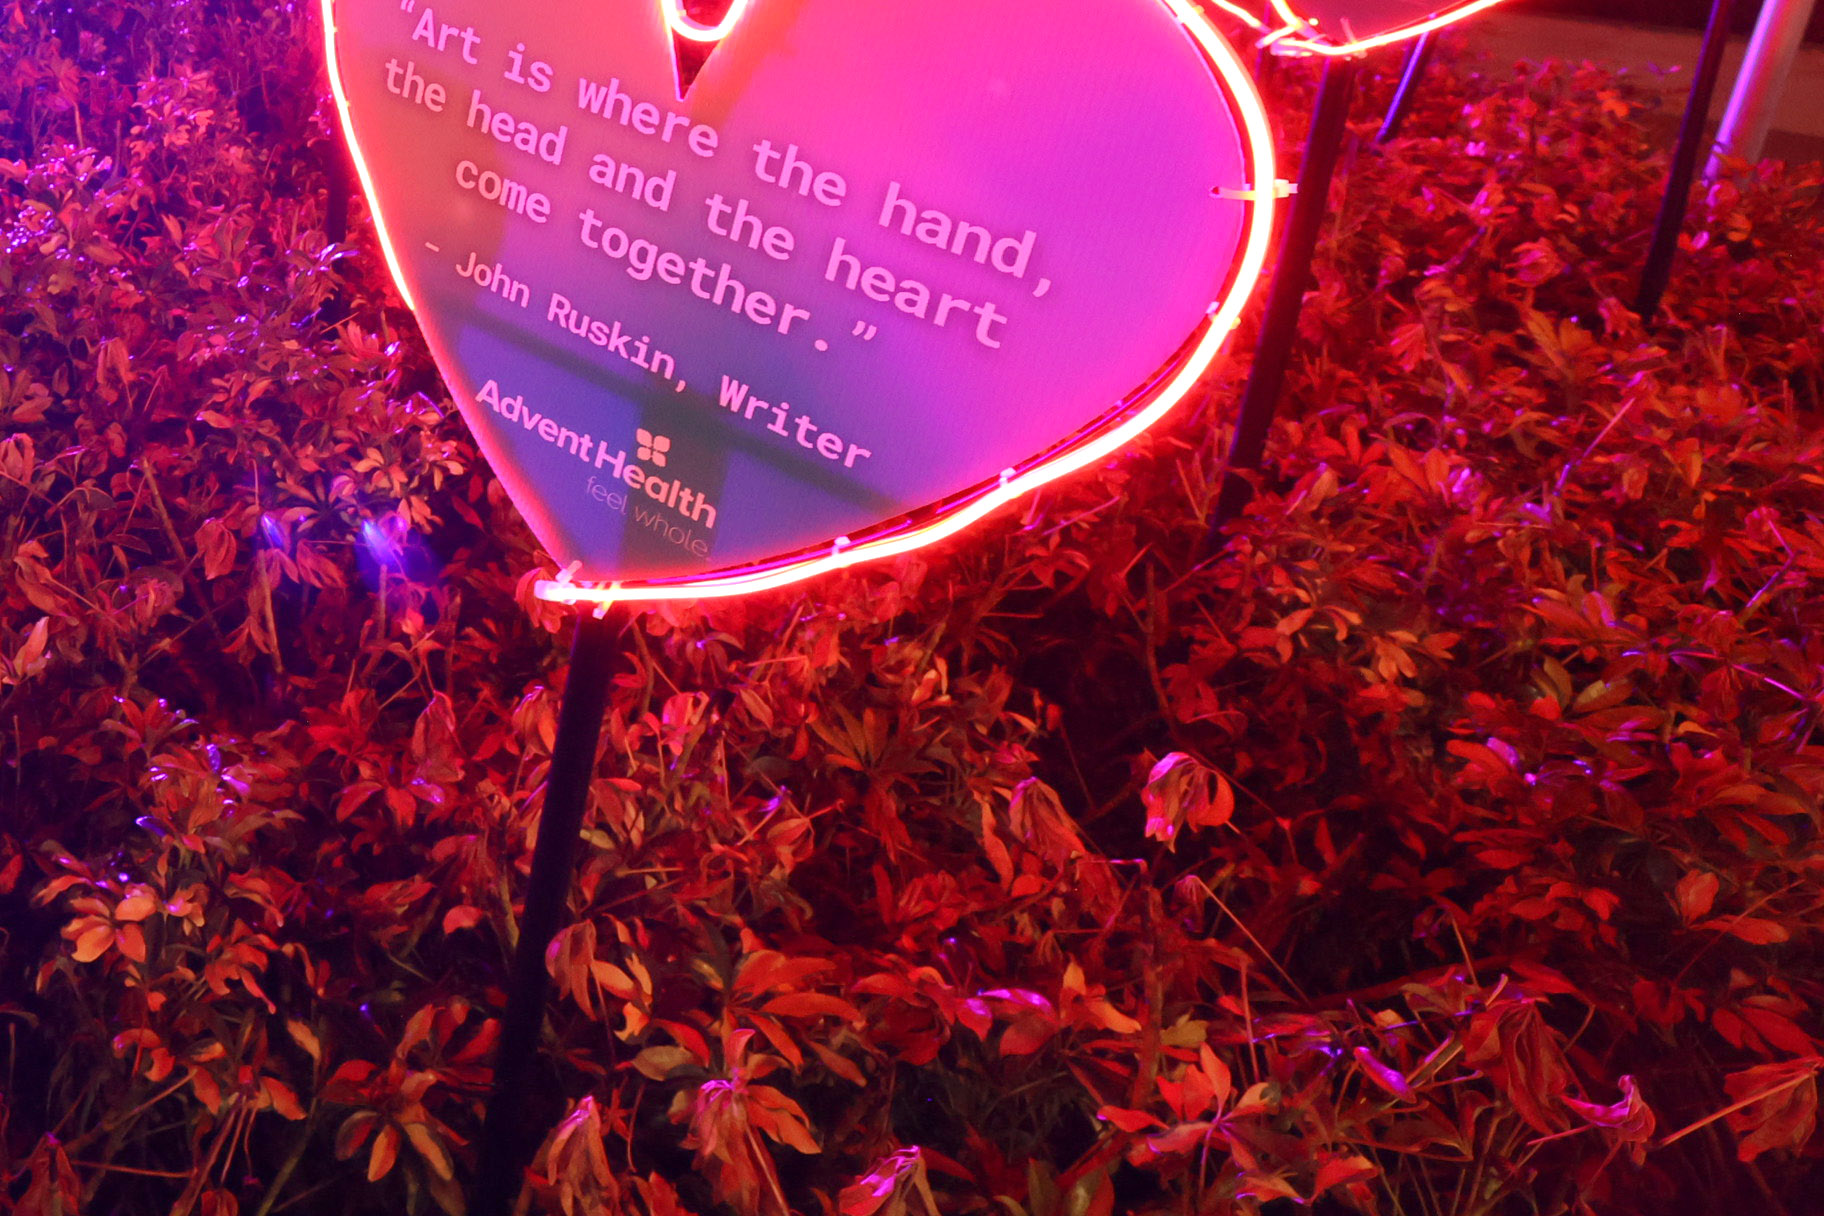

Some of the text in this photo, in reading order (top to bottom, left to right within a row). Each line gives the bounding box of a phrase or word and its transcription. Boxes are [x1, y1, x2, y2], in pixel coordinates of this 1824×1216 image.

[384, 58, 1007, 350] the head and the heart
[455, 159, 552, 223] come
[503, 43, 553, 92] is
[577, 76, 720, 157] where
[752, 139, 847, 207] the
[878, 182, 1052, 298] hand,
[455, 252, 531, 308] John
[547, 292, 688, 393] Ruskin,
[718, 374, 872, 469] Writer
[475, 379, 718, 529] AdventHealth
[584, 475, 709, 559] feel whole.
